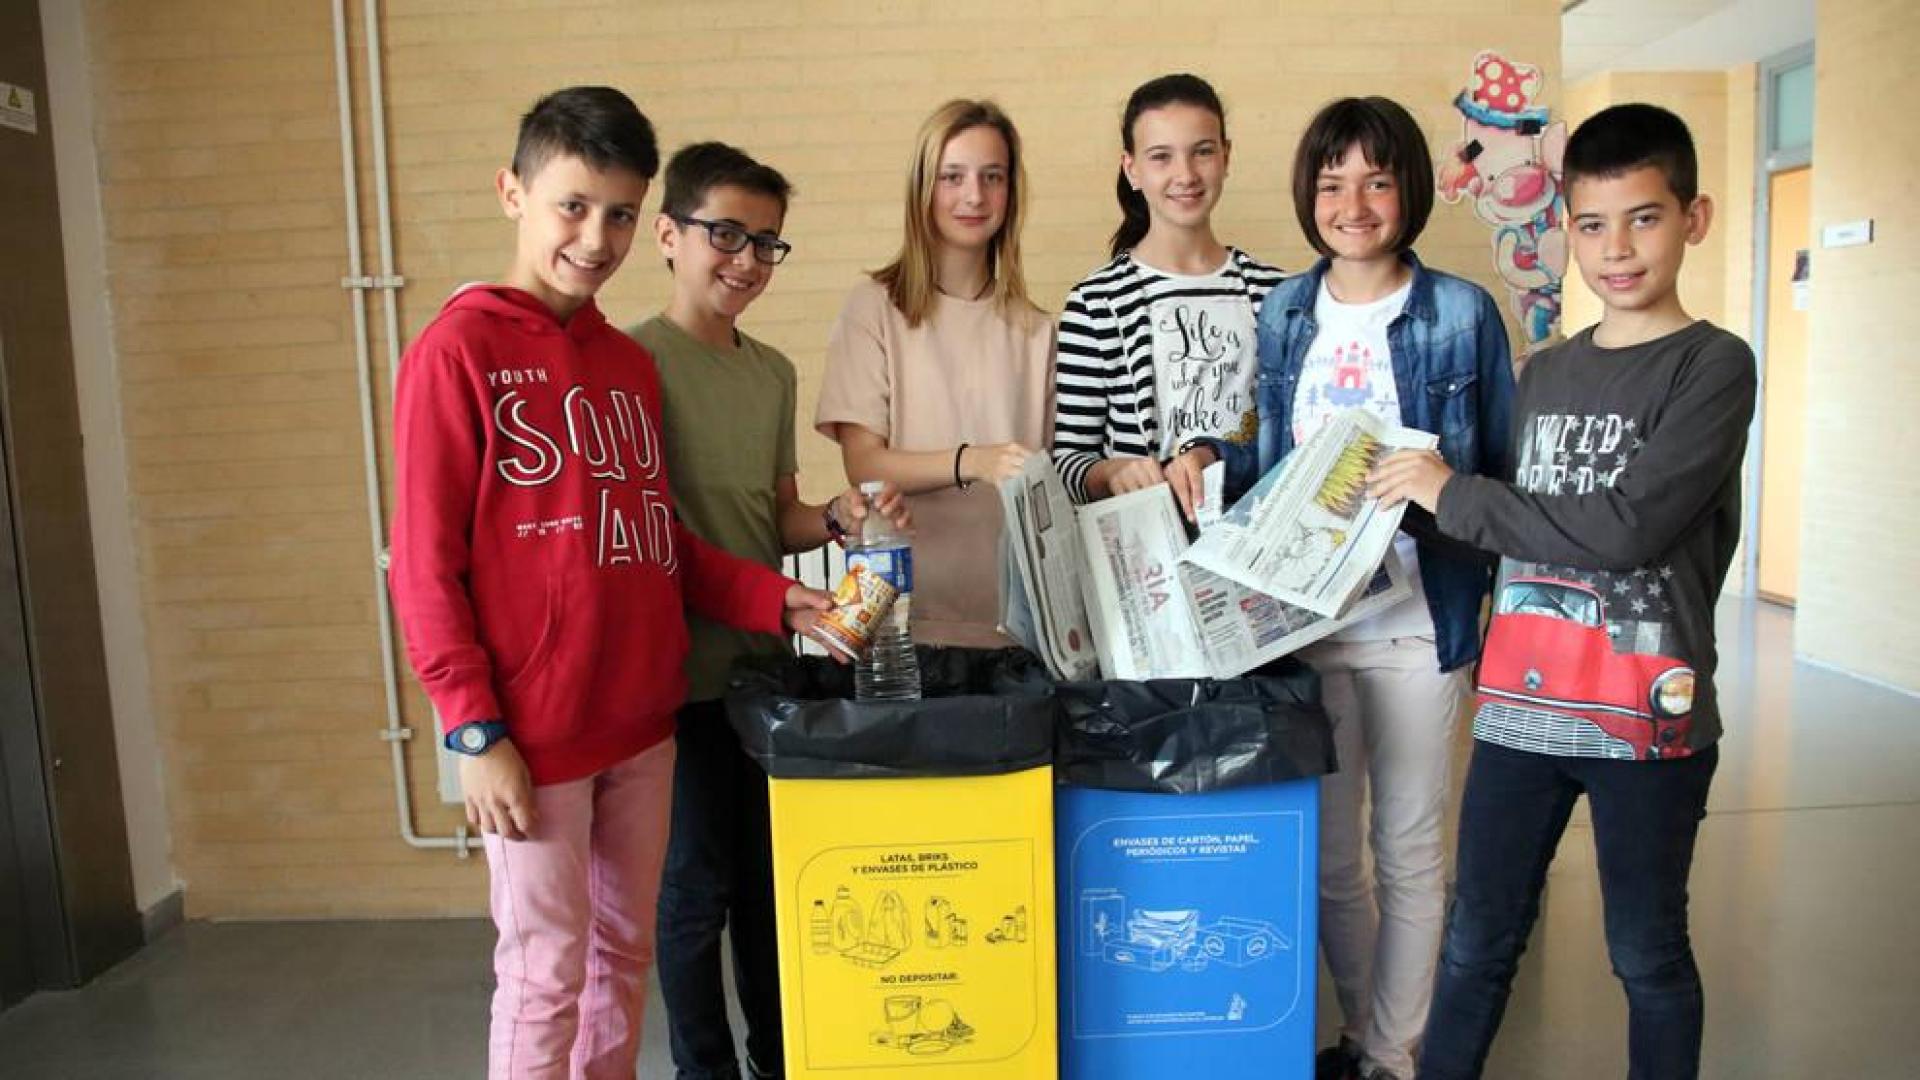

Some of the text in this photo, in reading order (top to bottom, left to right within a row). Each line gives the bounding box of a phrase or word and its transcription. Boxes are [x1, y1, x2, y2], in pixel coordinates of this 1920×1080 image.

[1159, 303, 1226, 362] Life
[486, 367, 548, 387] YOUTH
[1211, 361, 1241, 402] you
[1535, 412, 1623, 453] WILD
[1113, 836, 1159, 848] ENVASES
[1161, 836, 1175, 846] DE
[1190, 845, 1198, 854] Y
[1199, 843, 1247, 854] REVISTAS
[861, 863, 909, 874] ENVASES
[911, 863, 925, 872] DE
[880, 975, 897, 984] NO
